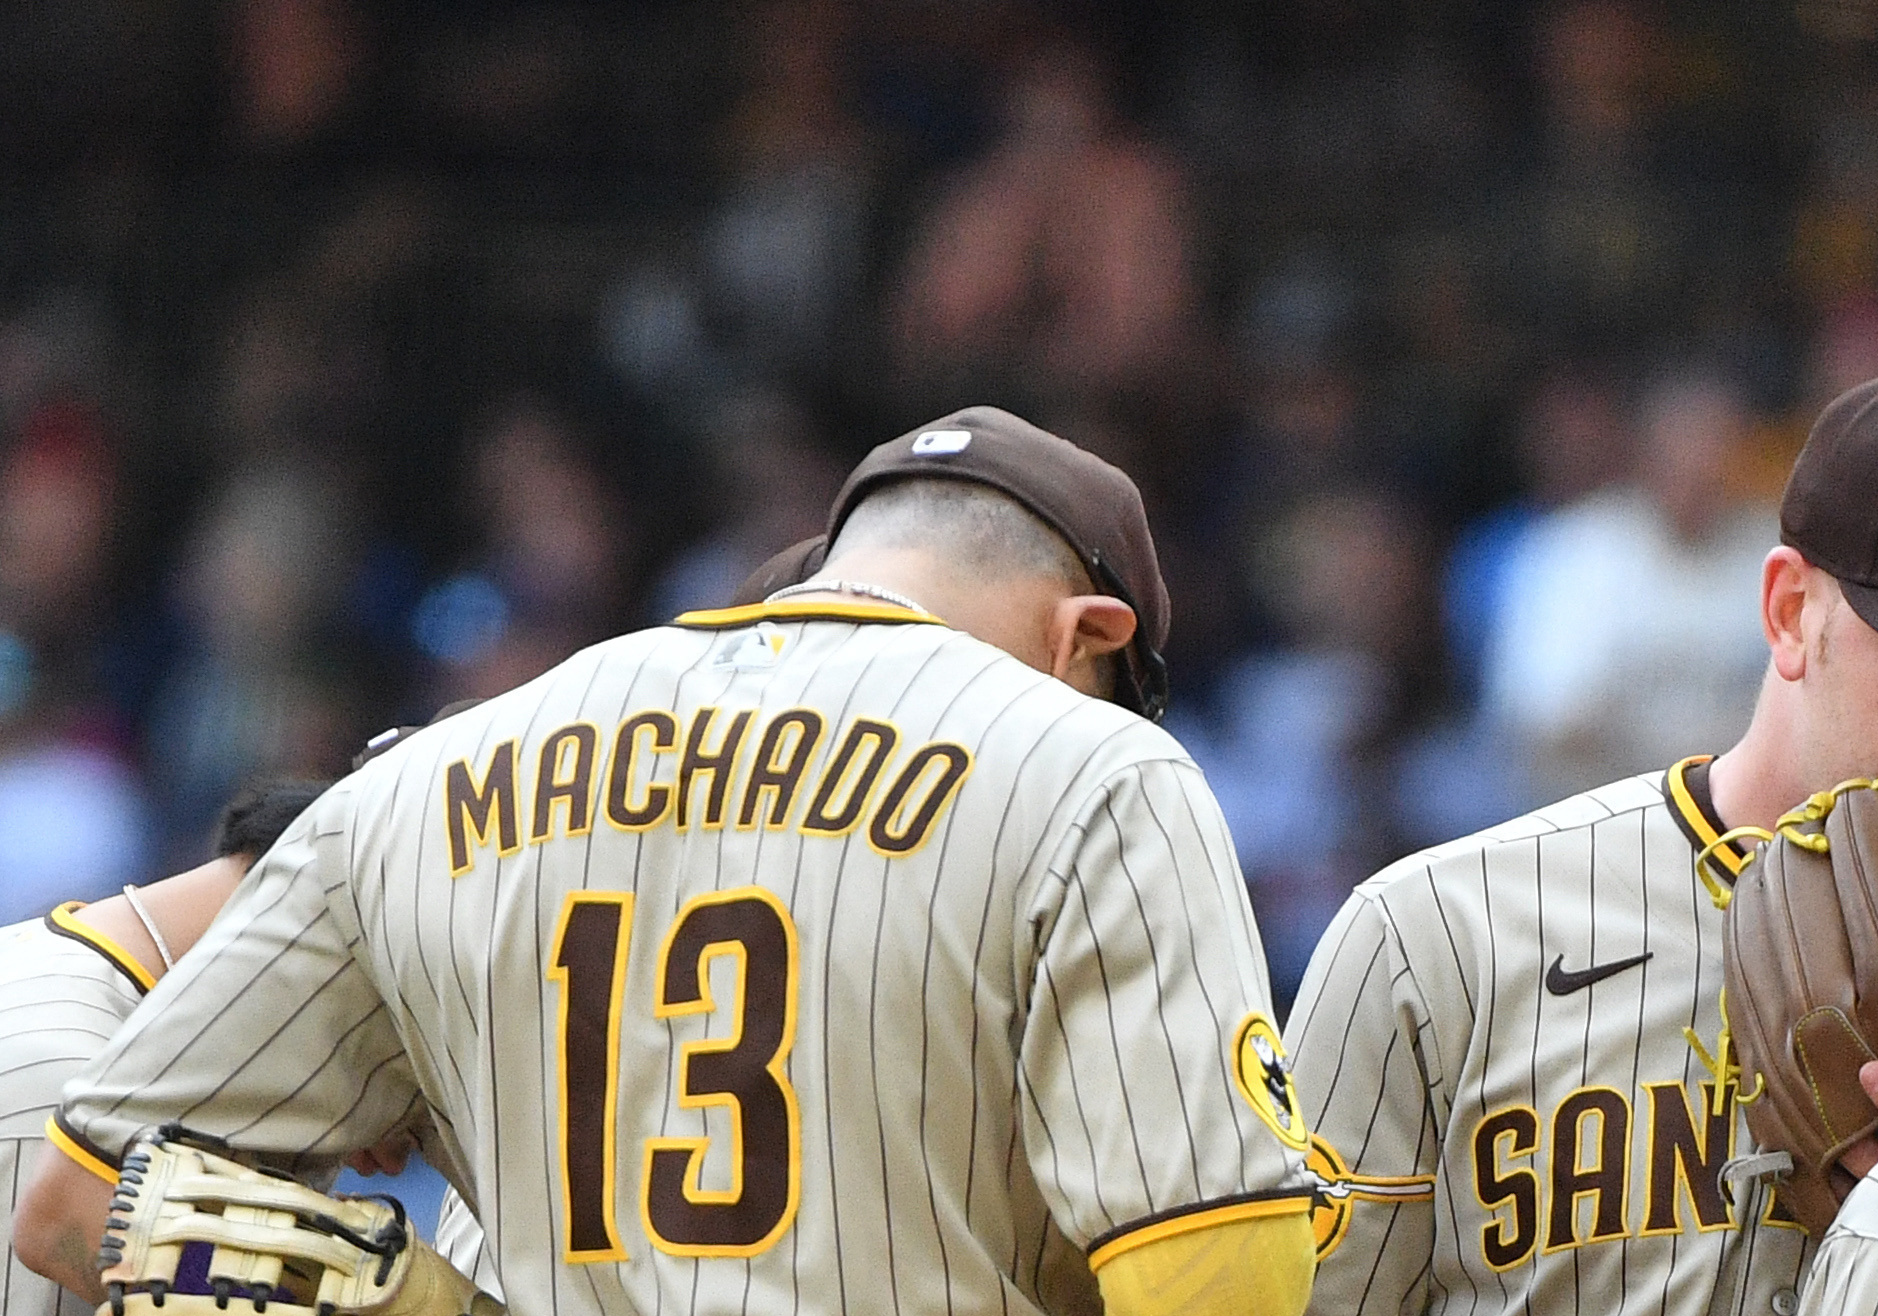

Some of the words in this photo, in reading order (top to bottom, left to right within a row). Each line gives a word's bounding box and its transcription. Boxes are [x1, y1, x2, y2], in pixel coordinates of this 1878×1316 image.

[445, 706, 974, 878] MACHADO
[547, 884, 800, 1263] 13
[1472, 1079, 1740, 1273] SAN
